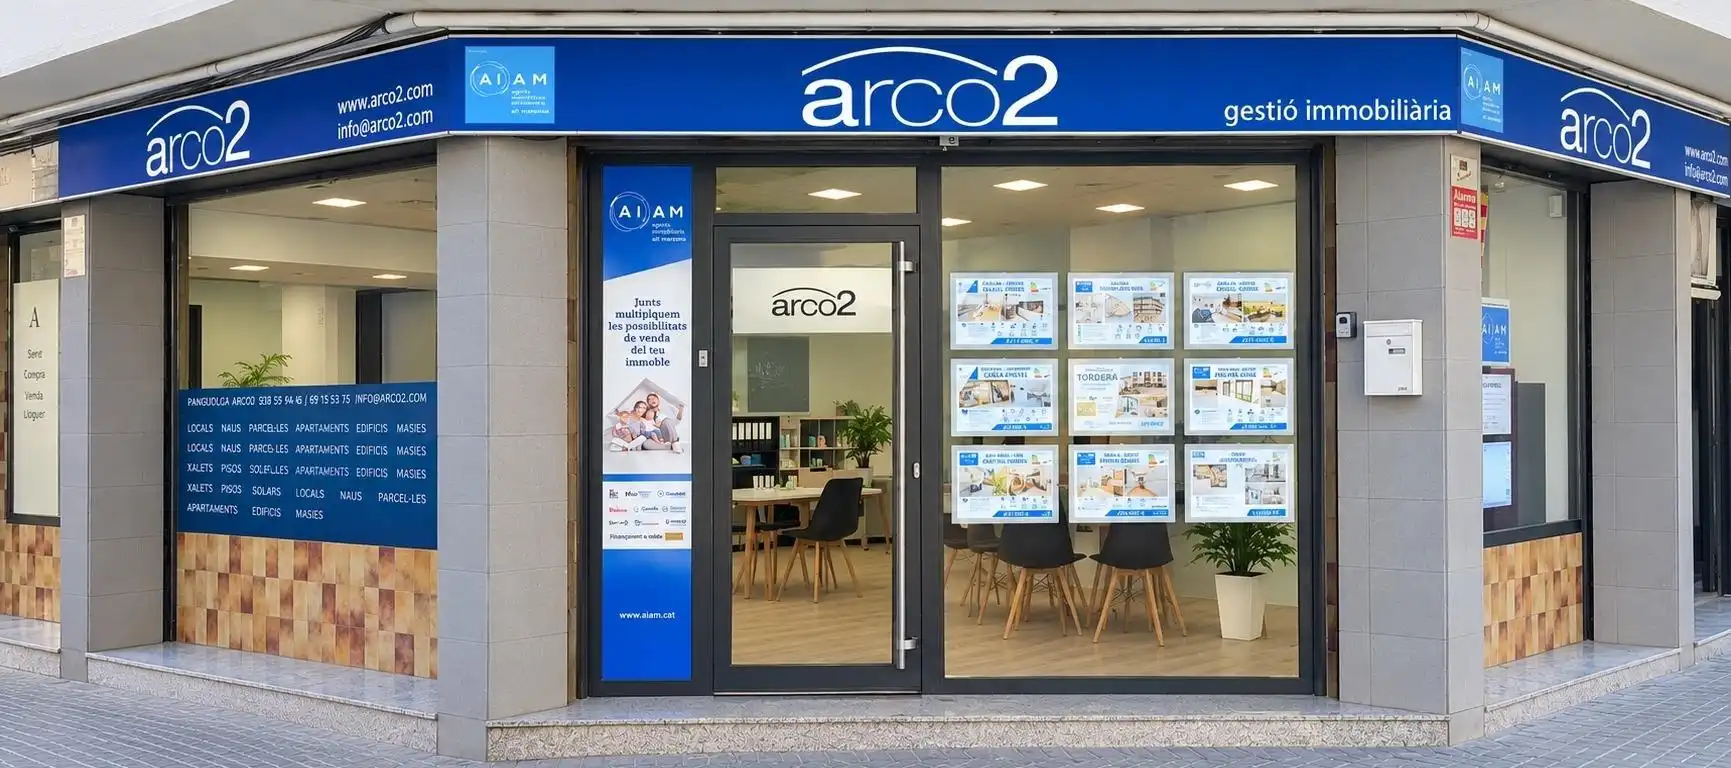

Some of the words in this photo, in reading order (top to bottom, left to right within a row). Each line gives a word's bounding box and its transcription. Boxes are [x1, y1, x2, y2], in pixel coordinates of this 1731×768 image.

[480, 72, 547, 85] AIAM
[337, 82, 433, 114] www.arco2.com
[800, 54, 1058, 127] arco2
[1224, 99, 1298, 127] gestió
[1306, 98, 1451, 121] immobiliària
[337, 108, 433, 140] info@arco2.com
[146, 100, 250, 177] arco2
[1560, 108, 1651, 169] arco2
[1684, 145, 1728, 167] www.arco2.com
[1684, 162, 1728, 187] info@arco2.com
[618, 205, 683, 218] AIAM
[634, 297, 662, 308] Junts
[771, 290, 856, 317] arco2
[29, 306, 41, 328] A
[608, 321, 623, 331] les
[623, 333, 637, 342] de
[639, 333, 671, 342] venda
[630, 345, 647, 355] del
[649, 346, 665, 354] teu
[625, 357, 671, 367] immoble
[355, 392, 427, 405] INFO@ARCO2.COM
[187, 423, 214, 433] LOCALS
[221, 423, 242, 433] NAUS
[295, 423, 349, 433] APARTAMENTS
[356, 423, 388, 433] EDIFICIS
[396, 423, 427, 433] MASIES
[187, 443, 214, 453] LOCALS
[221, 443, 242, 453] NAUS
[295, 444, 350, 455] APARTAMENTS
[356, 445, 388, 456] EDIFICIS
[396, 445, 427, 457] MASIES
[187, 463, 214, 473] XALETS
[221, 463, 242, 474] PISOS
[295, 465, 350, 477] APARTAMENTS
[356, 467, 388, 478] EDIFICIS
[396, 468, 427, 480] MASIES
[187, 483, 214, 493] XALETS
[221, 484, 242, 494] PISOS
[252, 486, 282, 497] SOLARS
[295, 488, 325, 499] LOCALS
[340, 491, 363, 501] NAUS
[187, 503, 238, 515] APARTAMENTS
[295, 509, 324, 520] MASIES
